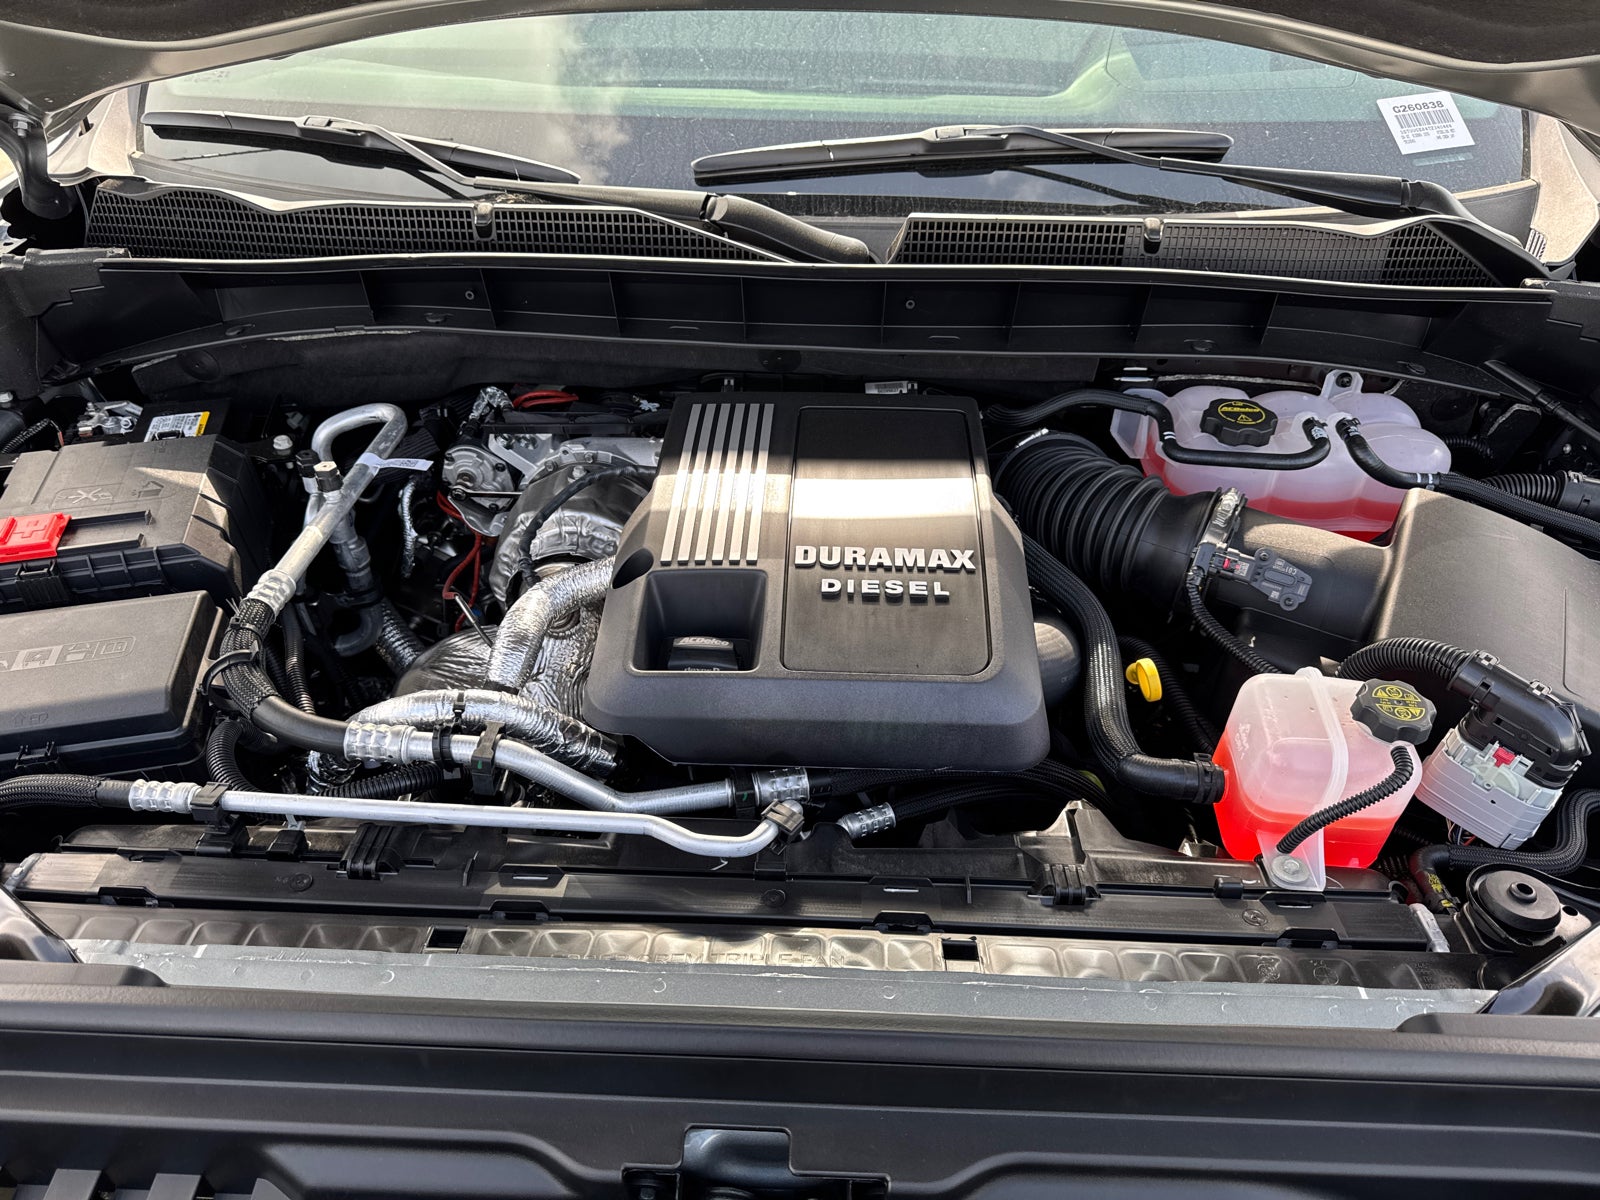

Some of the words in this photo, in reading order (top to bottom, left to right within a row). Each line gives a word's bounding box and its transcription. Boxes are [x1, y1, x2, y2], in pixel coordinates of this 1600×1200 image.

[794, 545, 976, 572] DURAMAX
[821, 578, 951, 599] DIESEL
[677, 636, 730, 646] ACDelco
